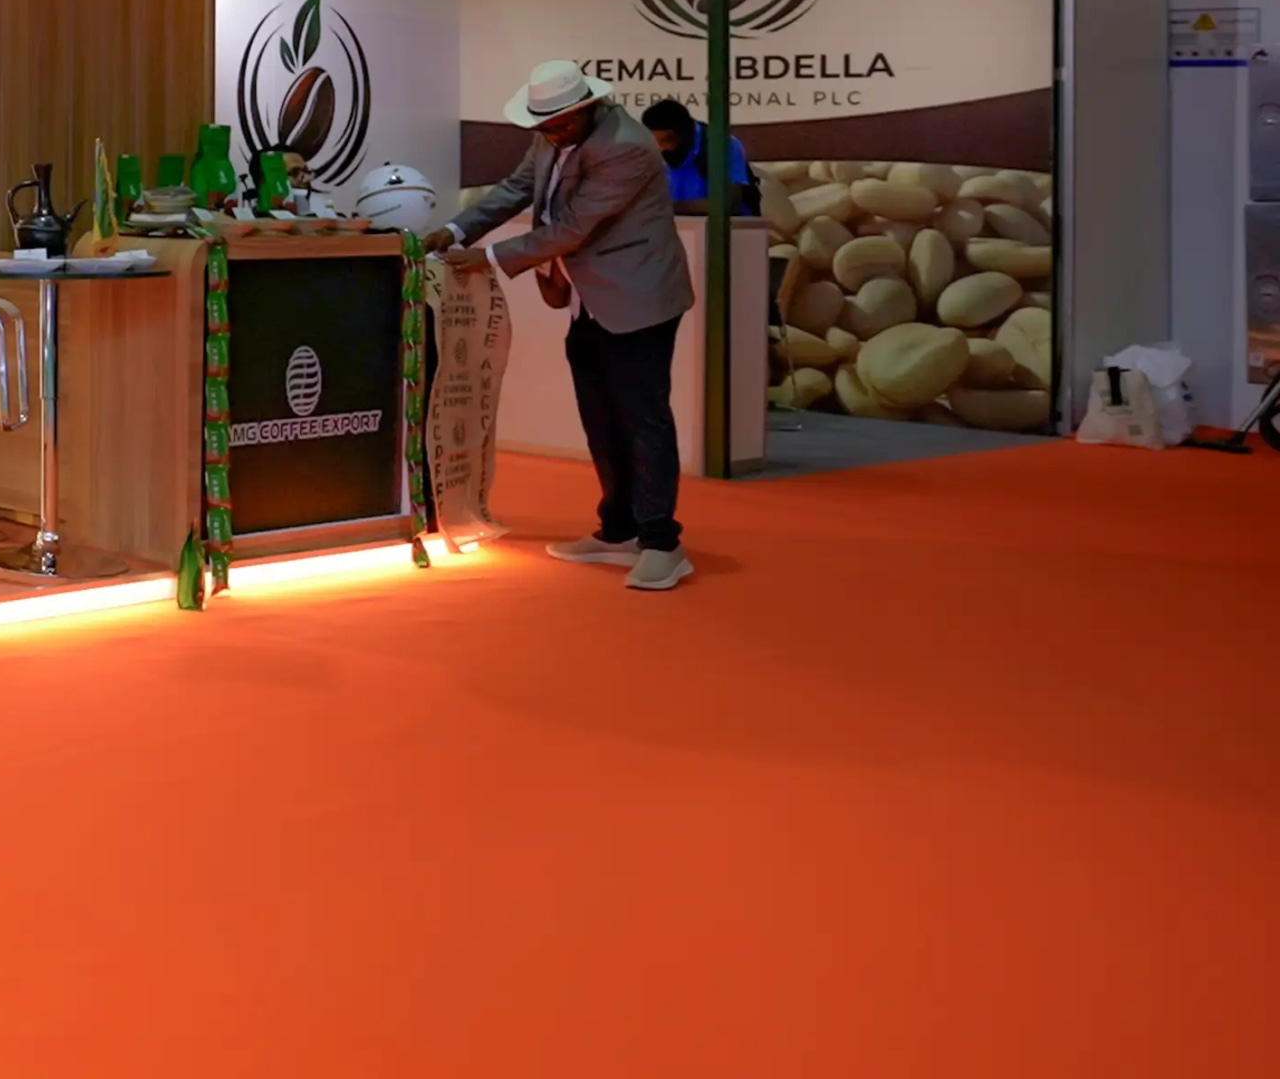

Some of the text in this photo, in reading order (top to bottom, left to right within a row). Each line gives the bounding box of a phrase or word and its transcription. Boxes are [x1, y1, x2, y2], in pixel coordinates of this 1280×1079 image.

[705, 52, 895, 80] BDELLA
[608, 90, 862, 107] NTERNATONAL PLC
[228, 410, 382, 447] MG COFFEE EXPORT
